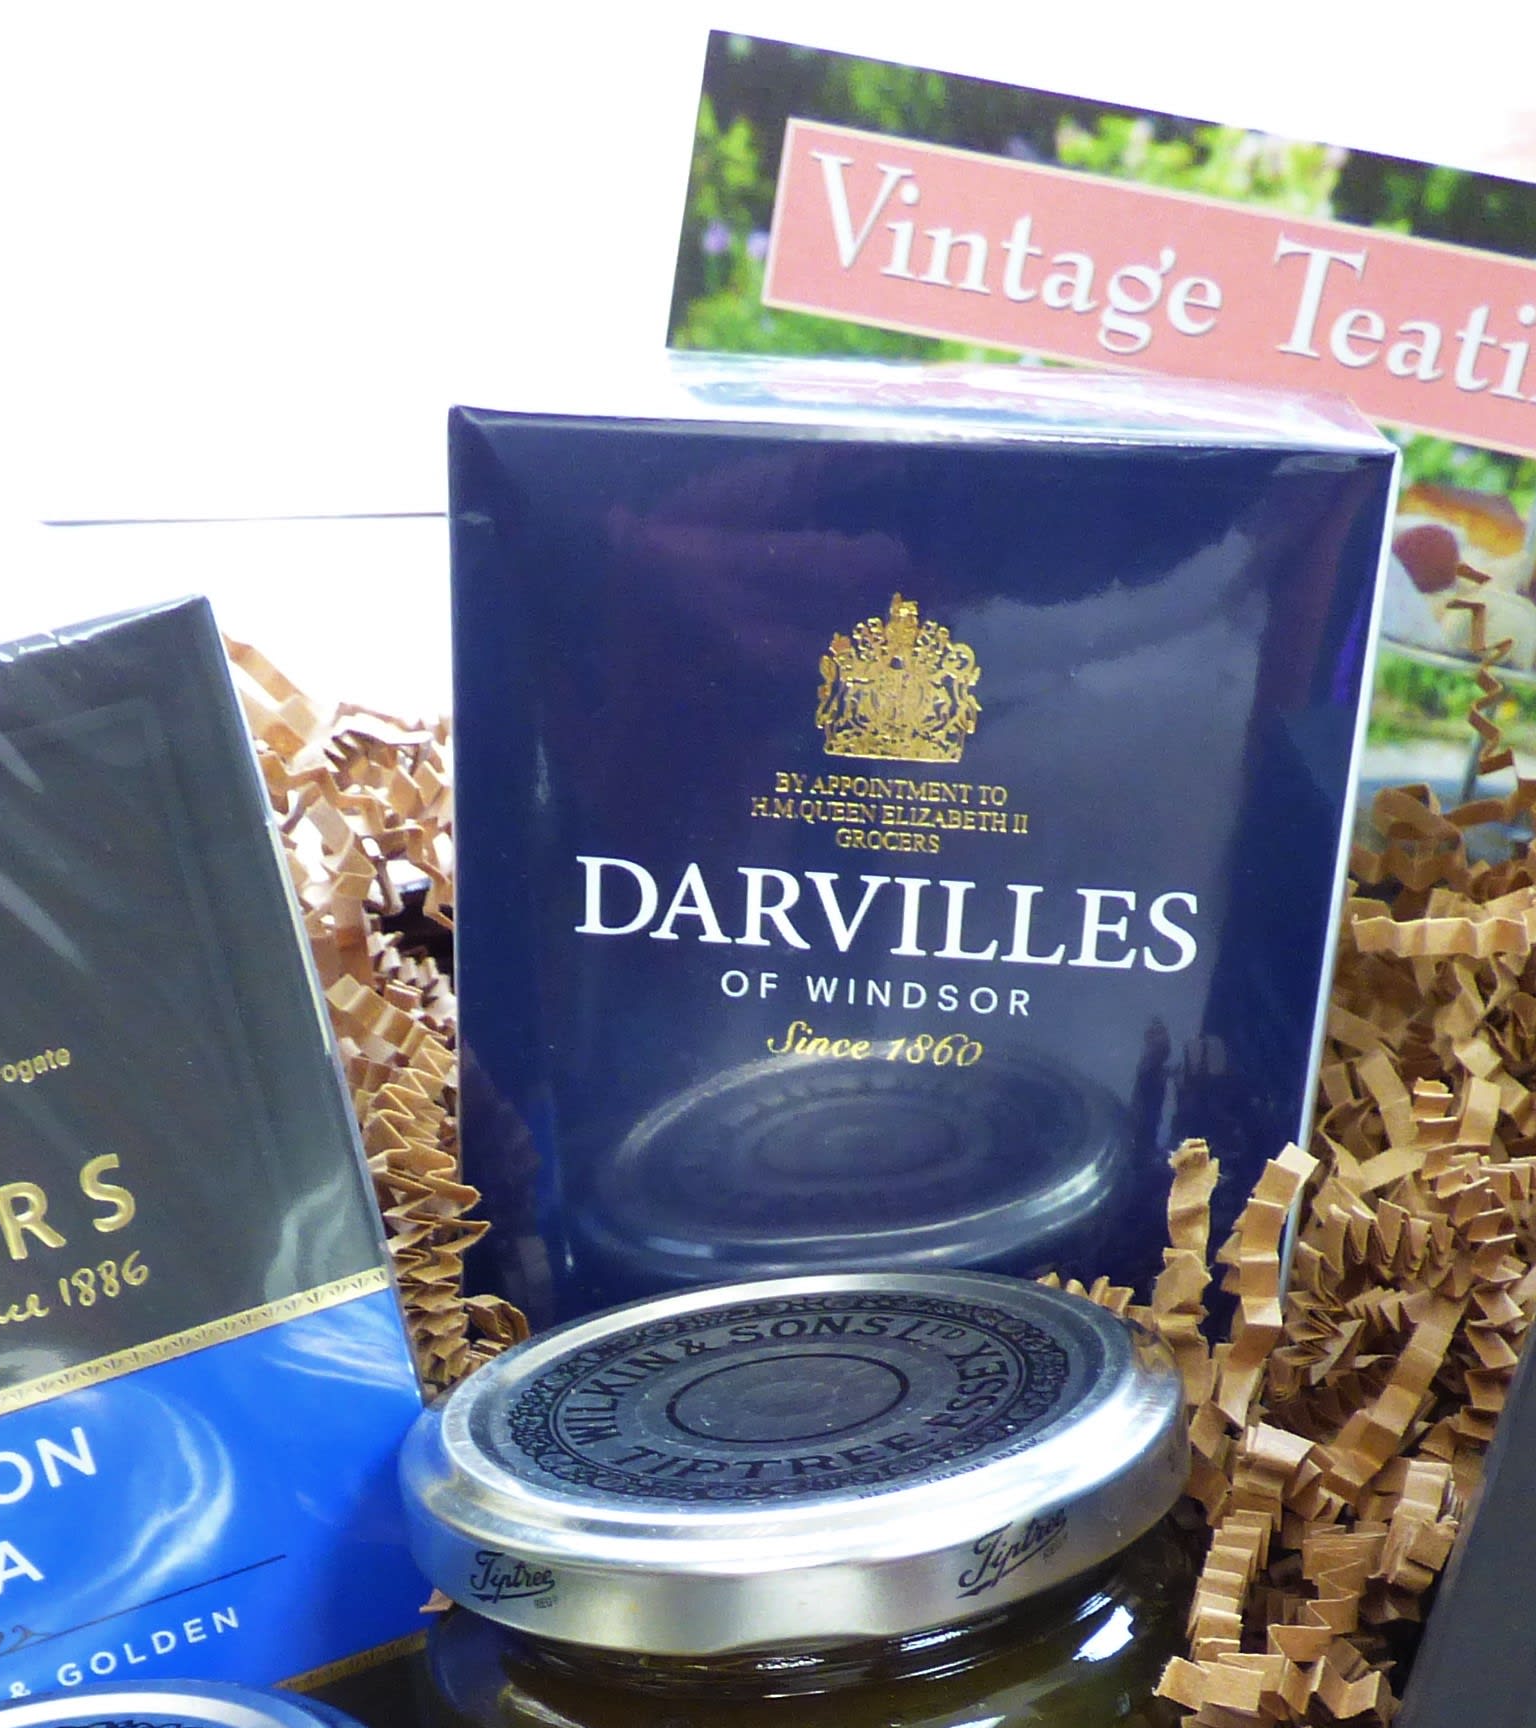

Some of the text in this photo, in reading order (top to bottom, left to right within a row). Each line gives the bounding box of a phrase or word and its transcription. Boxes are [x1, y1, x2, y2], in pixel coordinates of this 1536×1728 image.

[810, 151, 1222, 354] Vintage
[775, 771, 1008, 807] BY APPOINTMENT TO
[835, 827, 941, 855] GROCERS
[879, 804, 1009, 833] ELIZABETH
[1012, 812, 1029, 835] II
[574, 854, 1200, 974] DARVILLES
[720, 969, 1031, 1017] OF WINDSOR
[766, 1020, 984, 1068] Since 1860
[58, 1249, 150, 1309] 1886
[565, 1349, 680, 1447] WILKIN
[675, 1338, 714, 1357] &
[727, 1315, 890, 1345] SONS
[615, 1340, 1011, 1484] TIPTREE ESSEX
[469, 1549, 556, 1605] Tiptree
[8, 1606, 241, 1700] & GOLDEN
